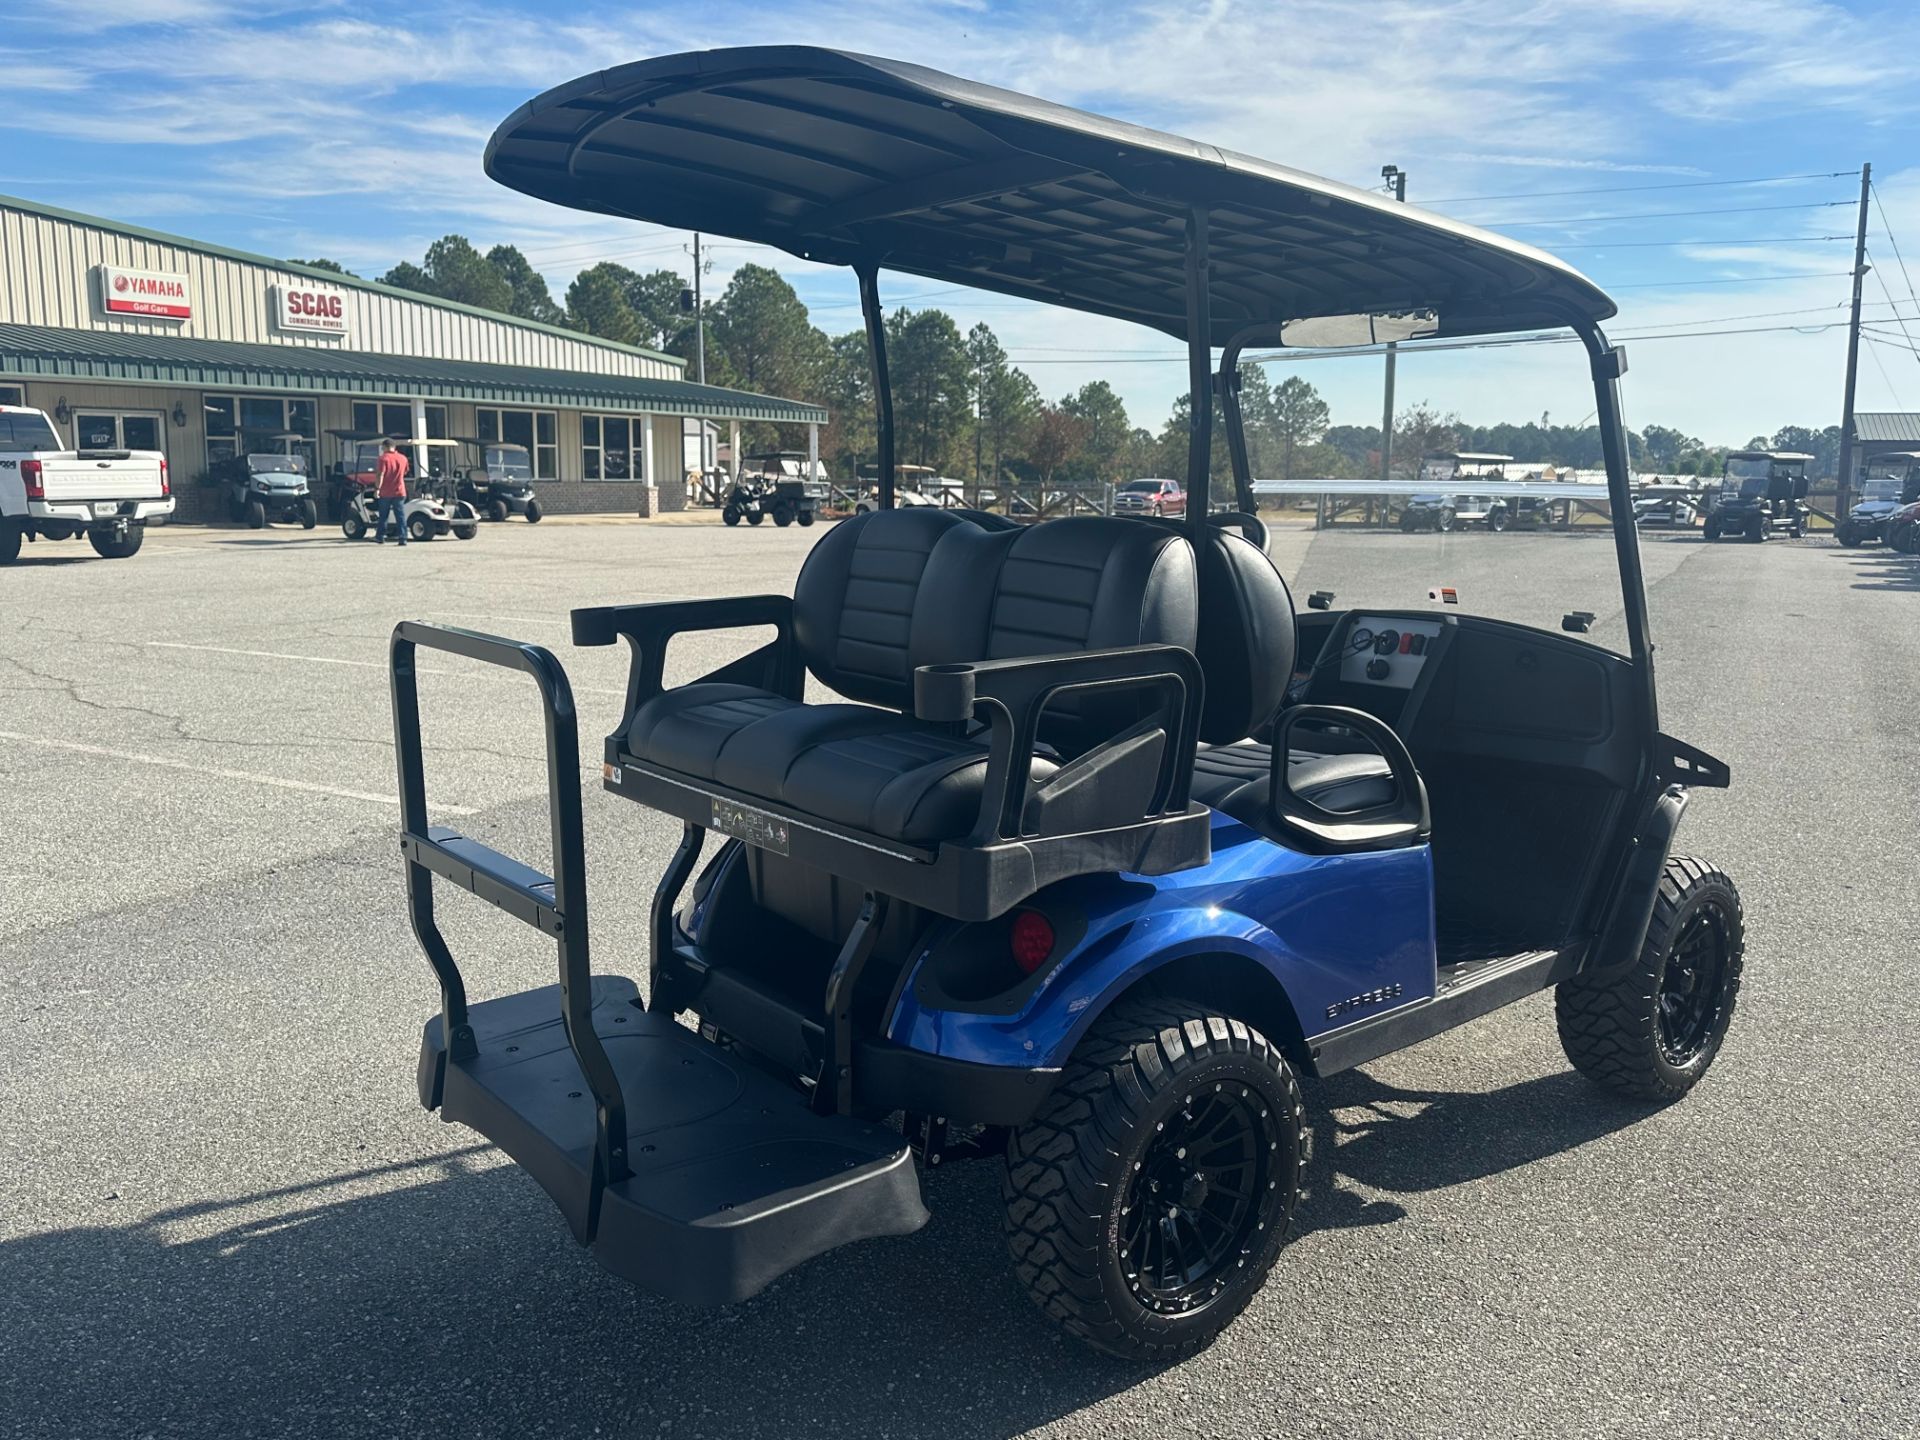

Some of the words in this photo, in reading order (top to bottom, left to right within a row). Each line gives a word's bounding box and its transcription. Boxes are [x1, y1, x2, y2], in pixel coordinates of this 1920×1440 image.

[130, 277, 184, 298] YAMAHA
[133, 303, 150, 312] Golf
[150, 304, 168, 314] Cars
[287, 291, 342, 318] SCAG
[289, 317, 320, 326] COMMERCIAL
